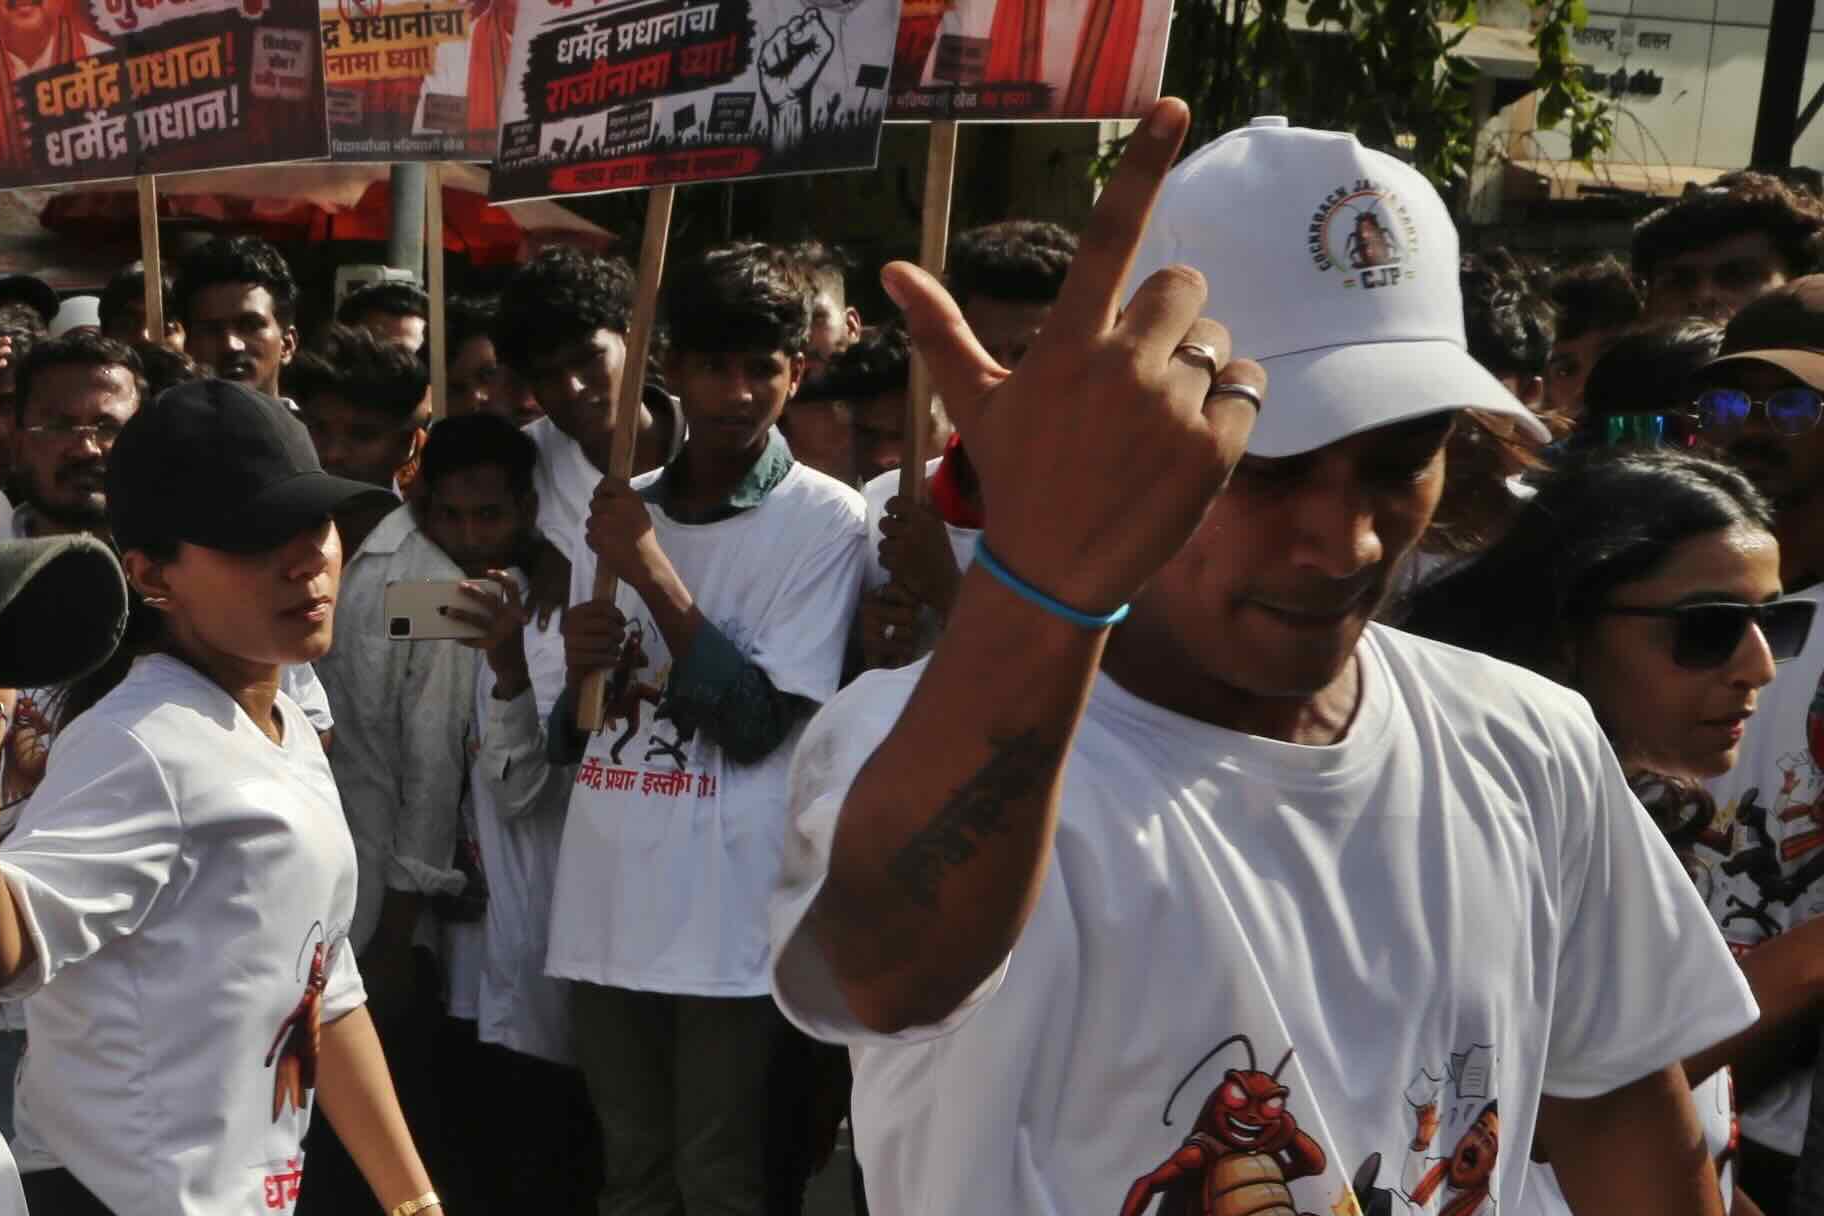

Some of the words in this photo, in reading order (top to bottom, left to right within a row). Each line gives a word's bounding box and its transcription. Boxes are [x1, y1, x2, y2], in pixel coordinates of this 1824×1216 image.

[557, 23, 609, 64] धर्मेंद्र
[617, 2, 719, 52] प्रधानांचा
[36, 57, 121, 116] धर्मेंद्र
[126, 31, 237, 99] प्रधान!
[545, 53, 672, 113] राजीनामा
[46, 109, 128, 167] धर्मेंद्र
[134, 84, 239, 149] प्रधान!
